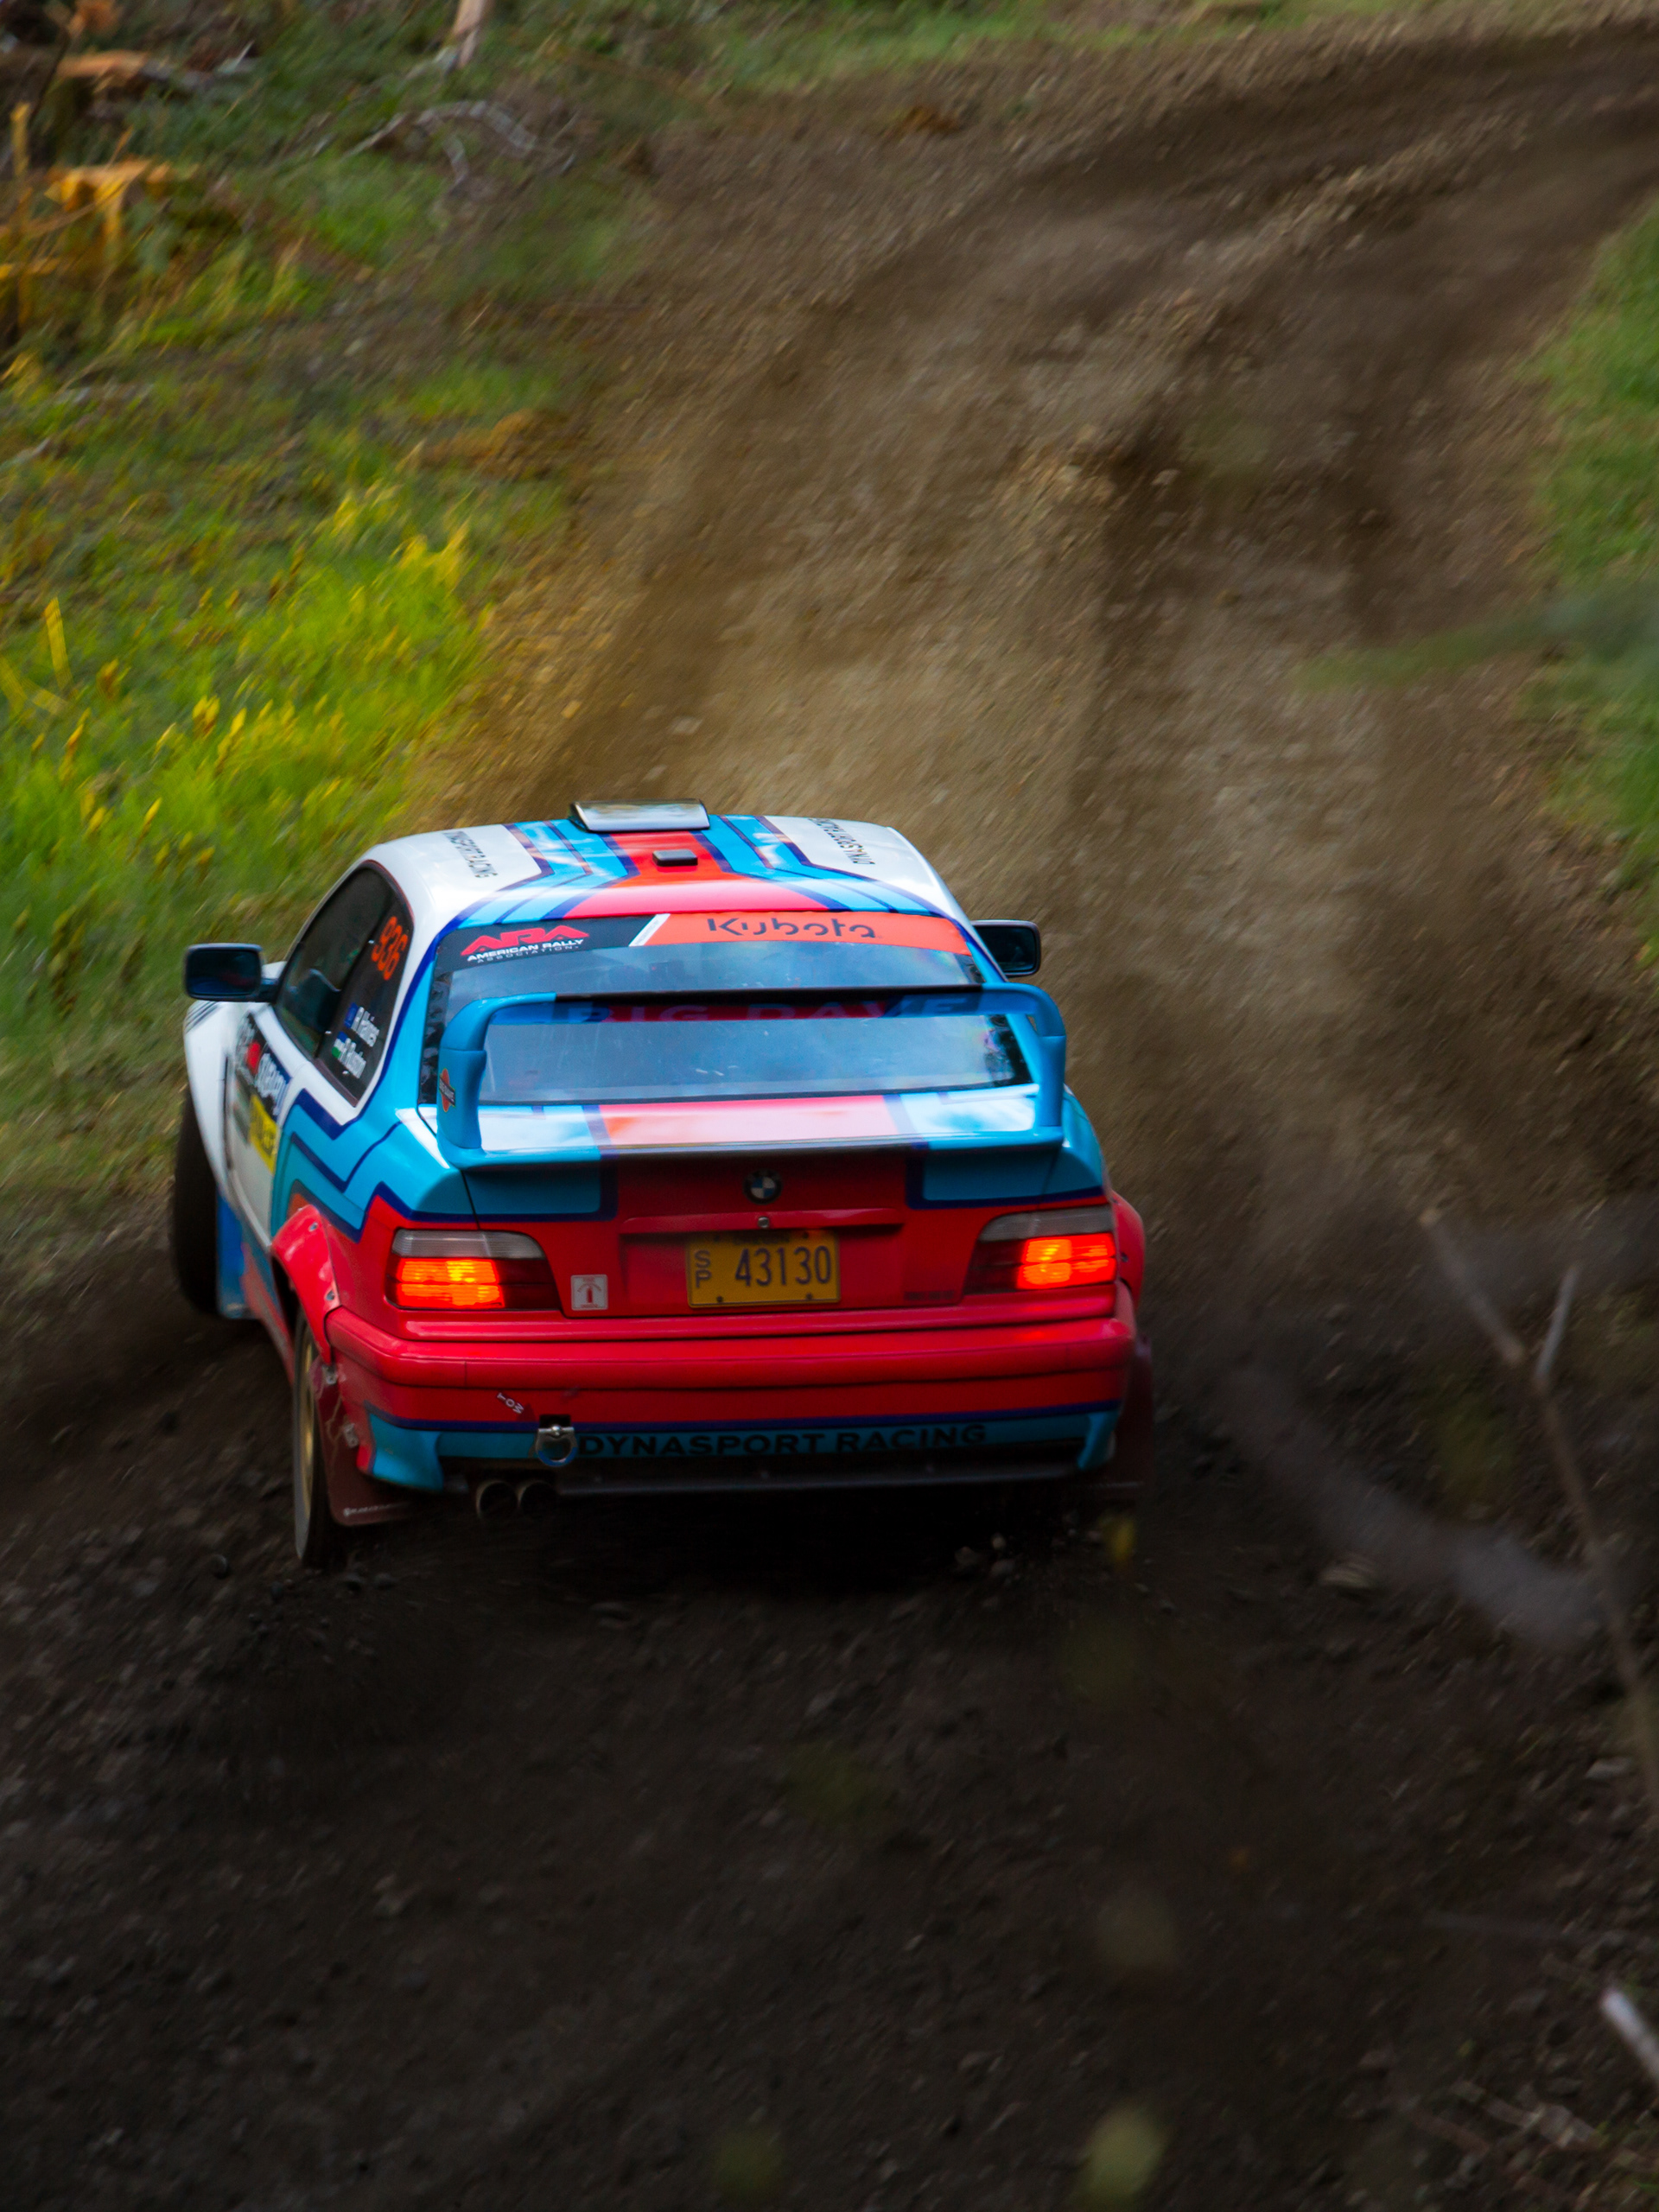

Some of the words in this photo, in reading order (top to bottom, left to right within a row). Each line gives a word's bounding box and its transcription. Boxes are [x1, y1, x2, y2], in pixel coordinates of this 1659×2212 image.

[461, 925, 589, 957] ARA
[707, 918, 876, 938] Kubota
[371, 917, 409, 982] 936
[467, 944, 539, 963] AMERICAN
[542, 938, 584, 949] RALLY
[477, 945, 573, 964] ASSOCIATION
[735, 1245, 832, 1287] 43130
[497, 1392, 524, 1414] TOW
[579, 1433, 824, 1456] DYNASPORT
[836, 1425, 986, 1452] RACING
